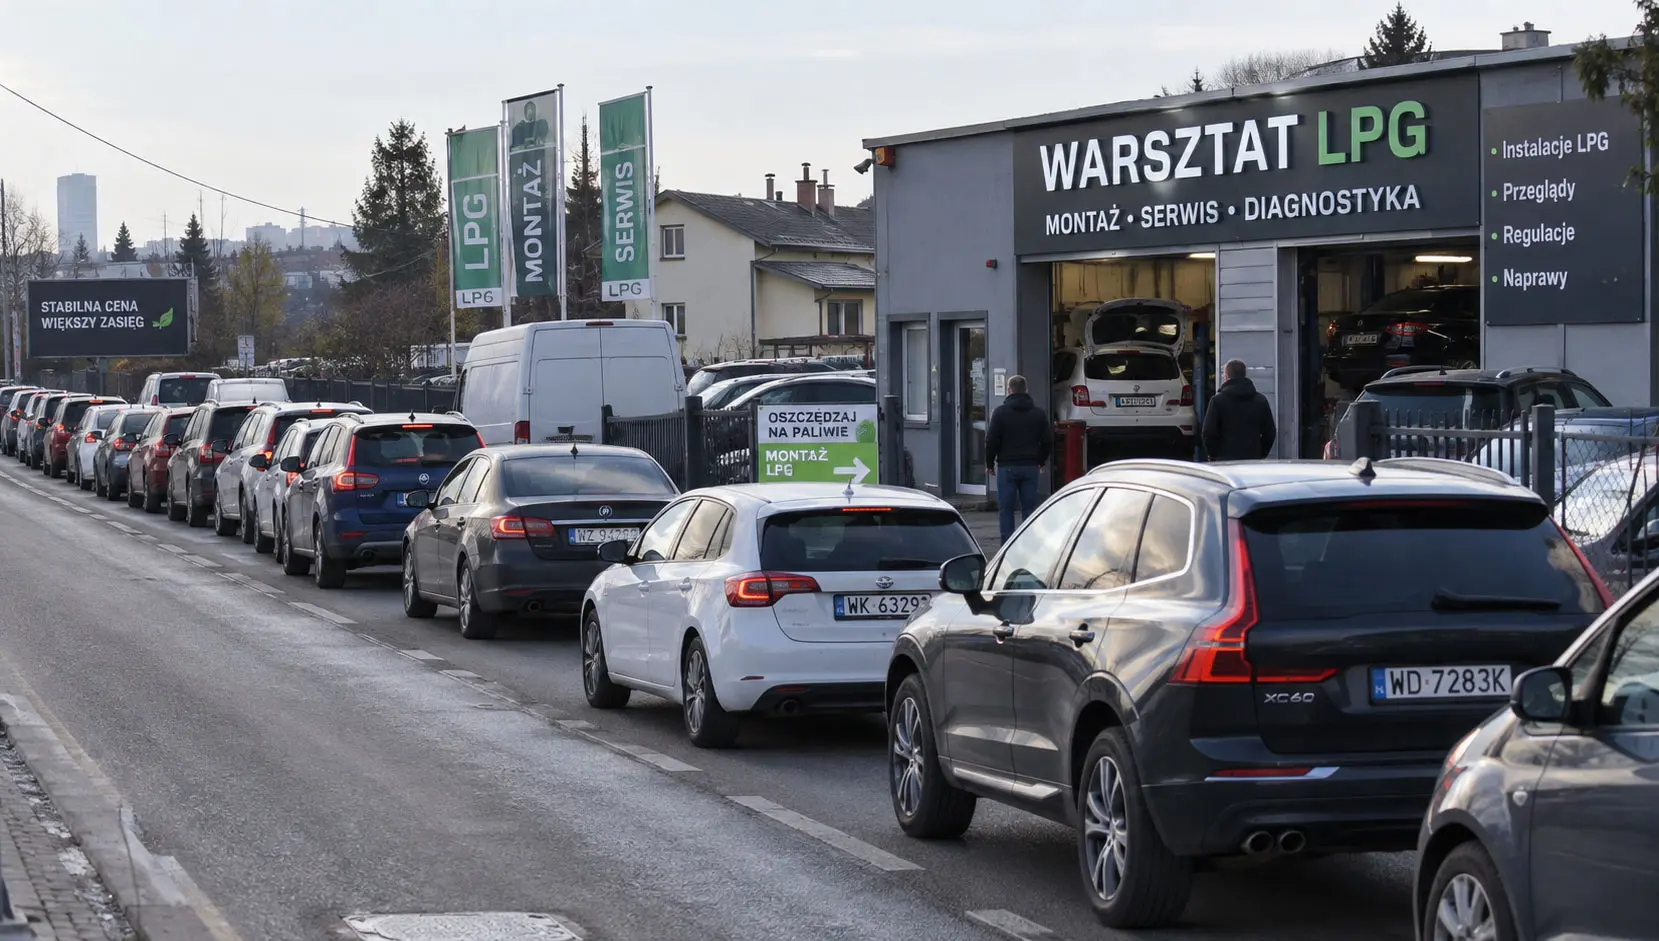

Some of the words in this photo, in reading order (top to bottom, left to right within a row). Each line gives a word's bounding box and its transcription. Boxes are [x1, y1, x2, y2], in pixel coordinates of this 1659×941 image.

[1040, 113, 1299, 192] WARSZTAT
[1317, 100, 1427, 166] LPG
[1503, 136, 1572, 159] Instalacje
[1577, 131, 1609, 153] LPG
[1503, 178, 1576, 203] Przeglądy
[517, 159, 543, 282] MONTAŻ
[615, 161, 634, 263] SERWIS
[1046, 203, 1121, 236] MONTAŻ
[1140, 200, 1220, 229] SERWIS
[1244, 184, 1421, 222] DIAGNOSTYKA
[462, 193, 489, 270] LPG
[1503, 222, 1575, 247] Regulacje
[1503, 268, 1568, 291] Naprawy
[41, 301, 102, 313] STABILNA
[105, 300, 138, 312] CENA
[41, 316, 97, 331] WIĘKSZY
[100, 316, 145, 330] ZASIĘG
[768, 427, 788, 438] NA
[792, 426, 849, 438] PALIWIE
[765, 447, 829, 462] MONTAŻ
[766, 464, 793, 476] LPG
[847, 596, 870, 614] WK
[1390, 669, 1422, 696] WD
[1432, 667, 1506, 695] 7283K
[1264, 692, 1315, 704] XC60
